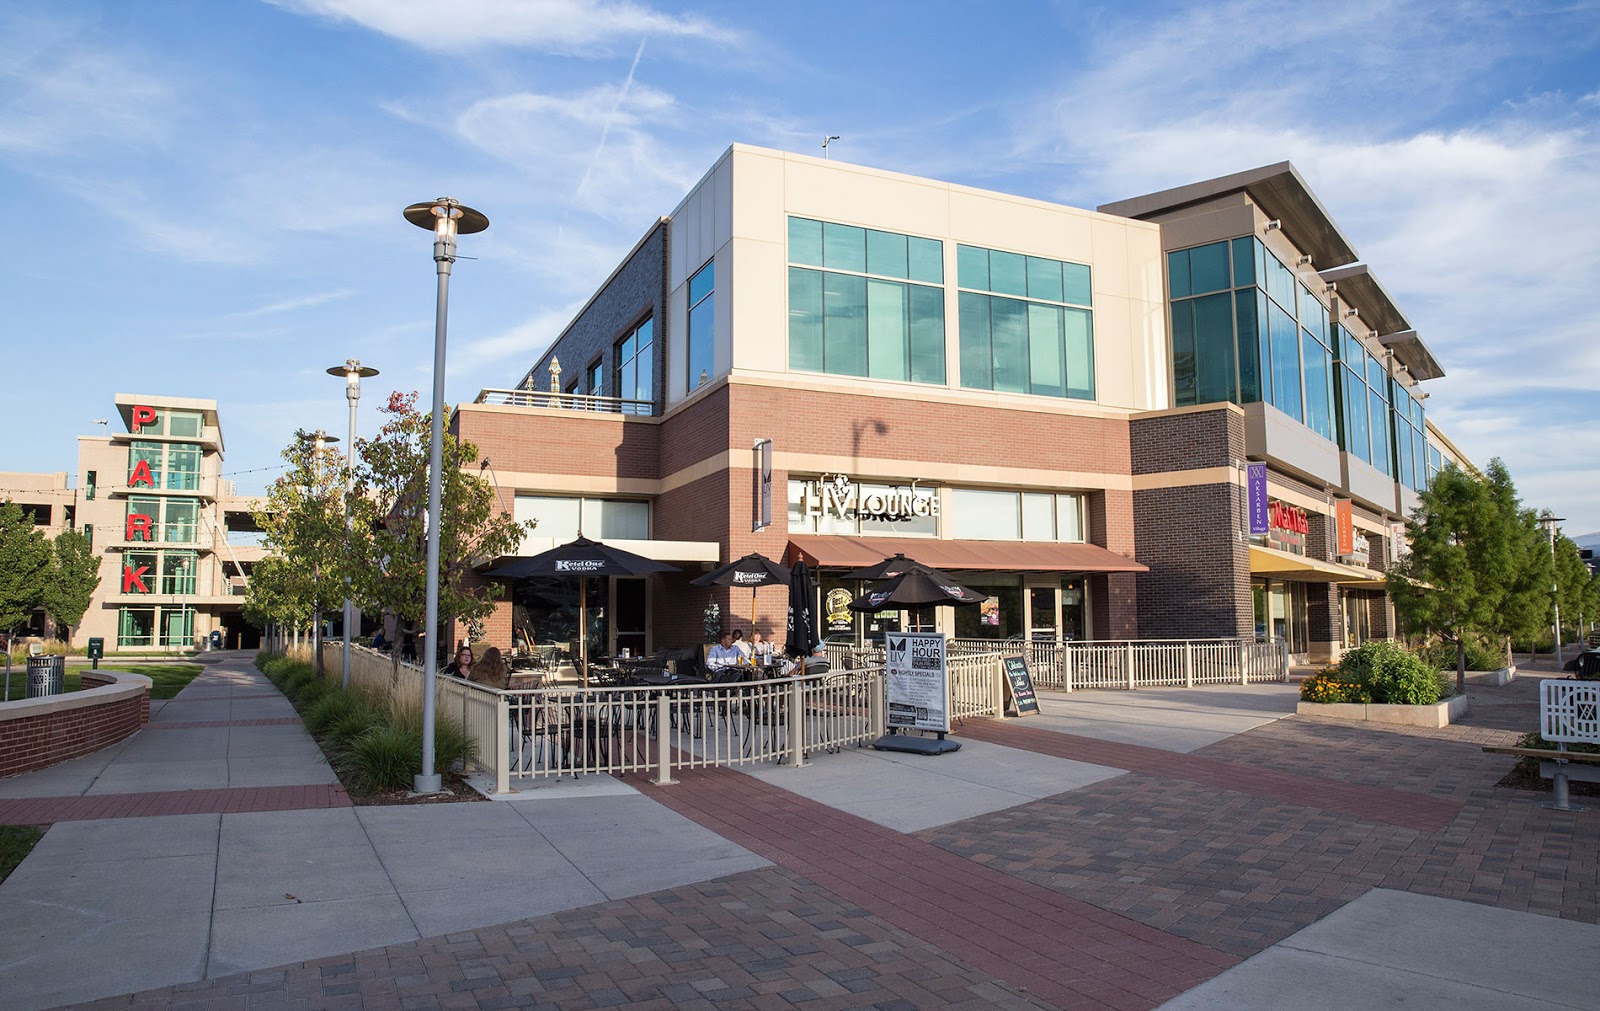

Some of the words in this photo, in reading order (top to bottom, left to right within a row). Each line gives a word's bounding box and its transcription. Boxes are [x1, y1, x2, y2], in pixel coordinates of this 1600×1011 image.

[123, 405, 156, 593] PARK
[804, 480, 856, 519] LIV
[858, 493, 940, 517] LOUNGE
[1254, 480, 1262, 525] AKSARBEN
[555, 560, 584, 571] Ketel
[584, 560, 605, 568] One
[733, 570, 754, 583] Ketel
[912, 638, 941, 648] HAPPY
[890, 651, 906, 663] LIV
[912, 647, 941, 658] HOUR
[914, 670, 935, 678] SPECIALS
